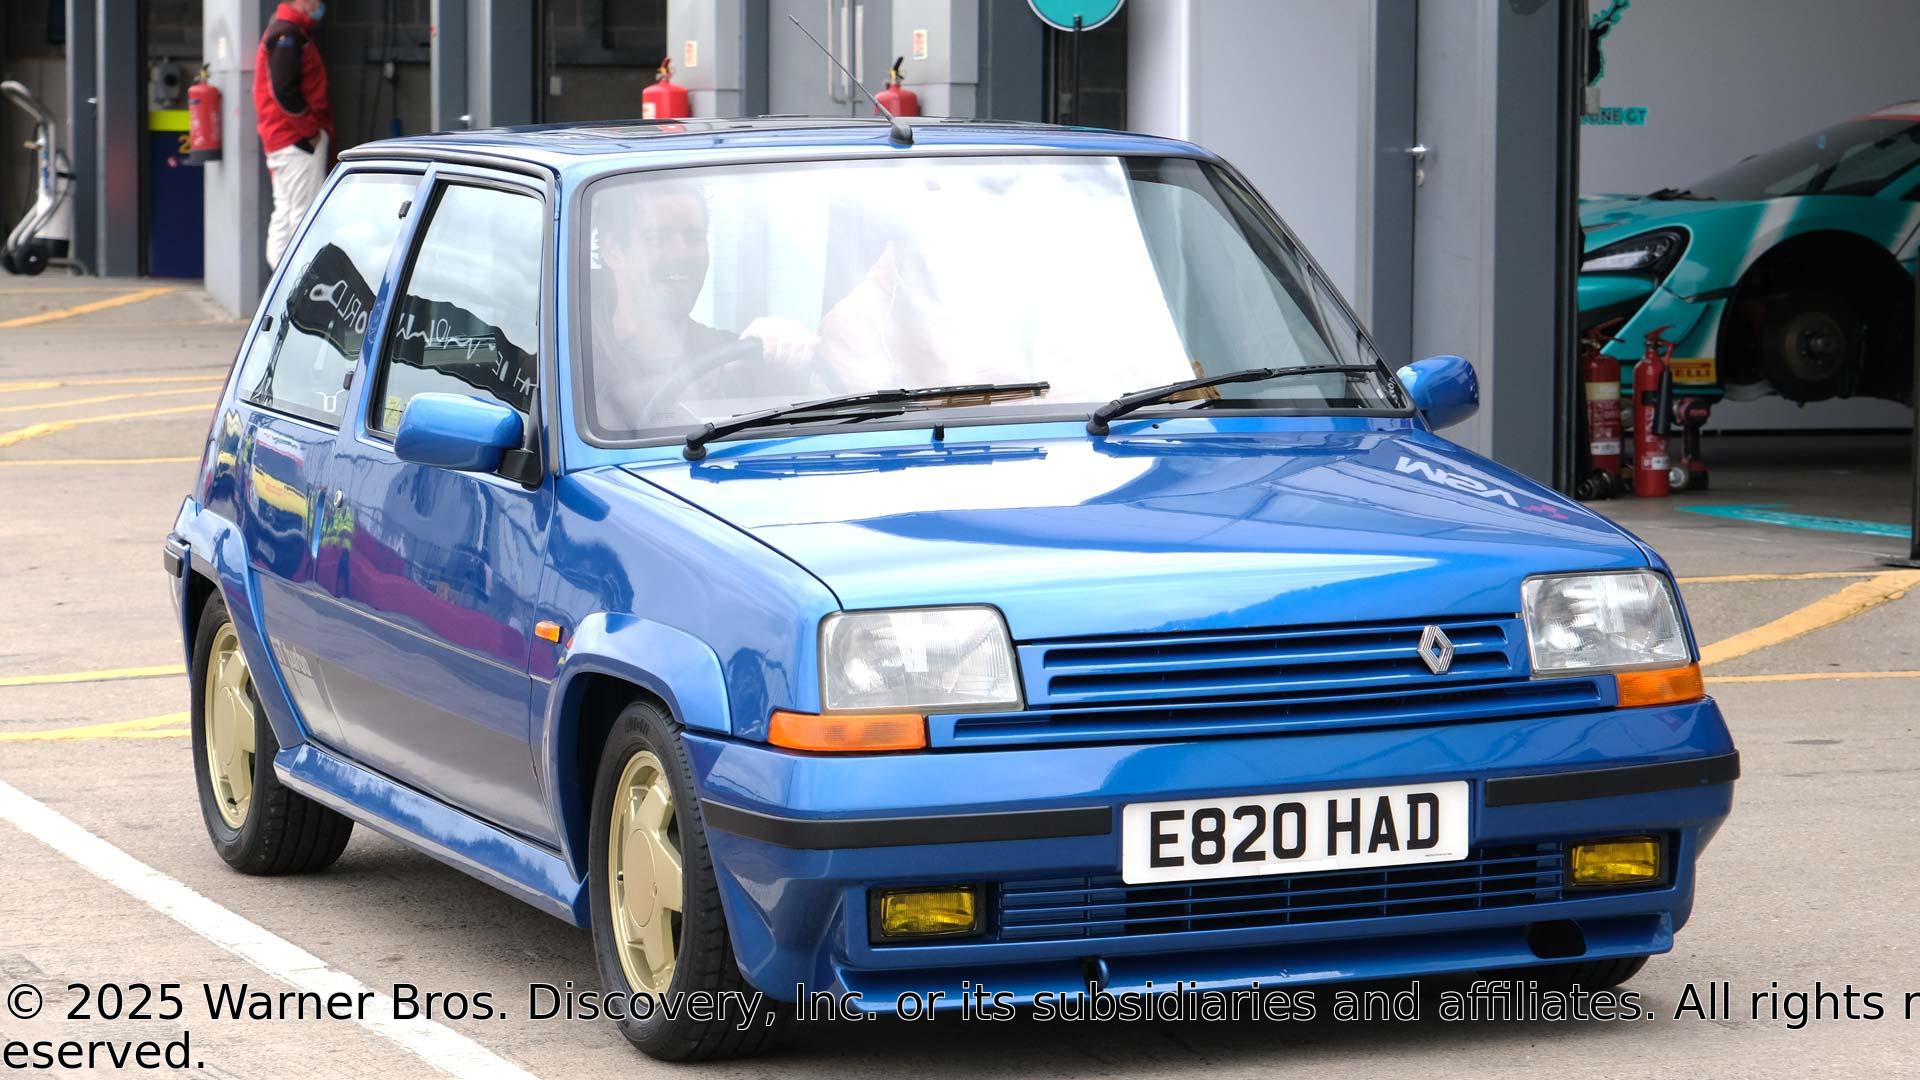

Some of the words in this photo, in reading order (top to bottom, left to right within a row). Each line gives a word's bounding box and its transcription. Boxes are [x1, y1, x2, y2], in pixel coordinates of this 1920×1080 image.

[1626, 110, 1648, 122] GT
[1150, 801, 1307, 869] E820
[1327, 792, 1440, 857] HAD
